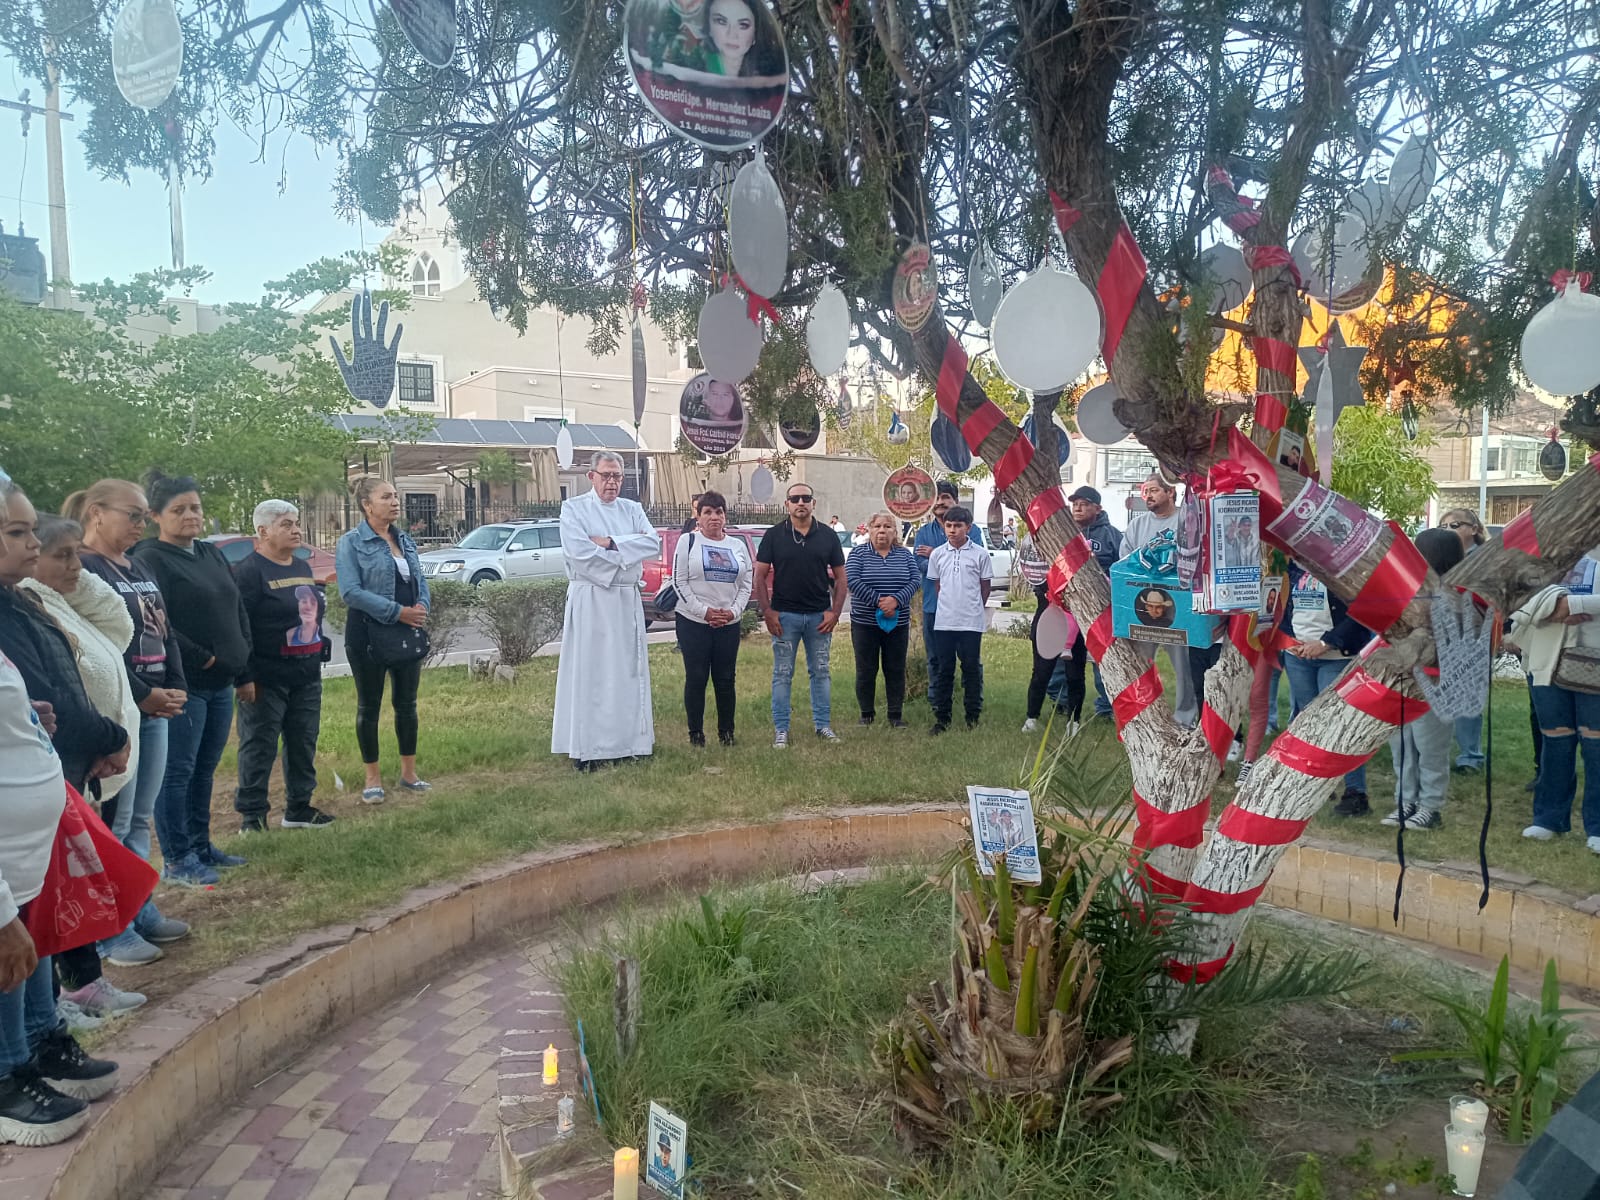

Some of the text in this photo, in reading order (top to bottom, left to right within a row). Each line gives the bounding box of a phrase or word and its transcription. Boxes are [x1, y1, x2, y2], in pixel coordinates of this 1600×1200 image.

[706, 98, 746, 115] Hernandez
[679, 120, 692, 129] 11
[694, 122, 726, 135] Agosto
